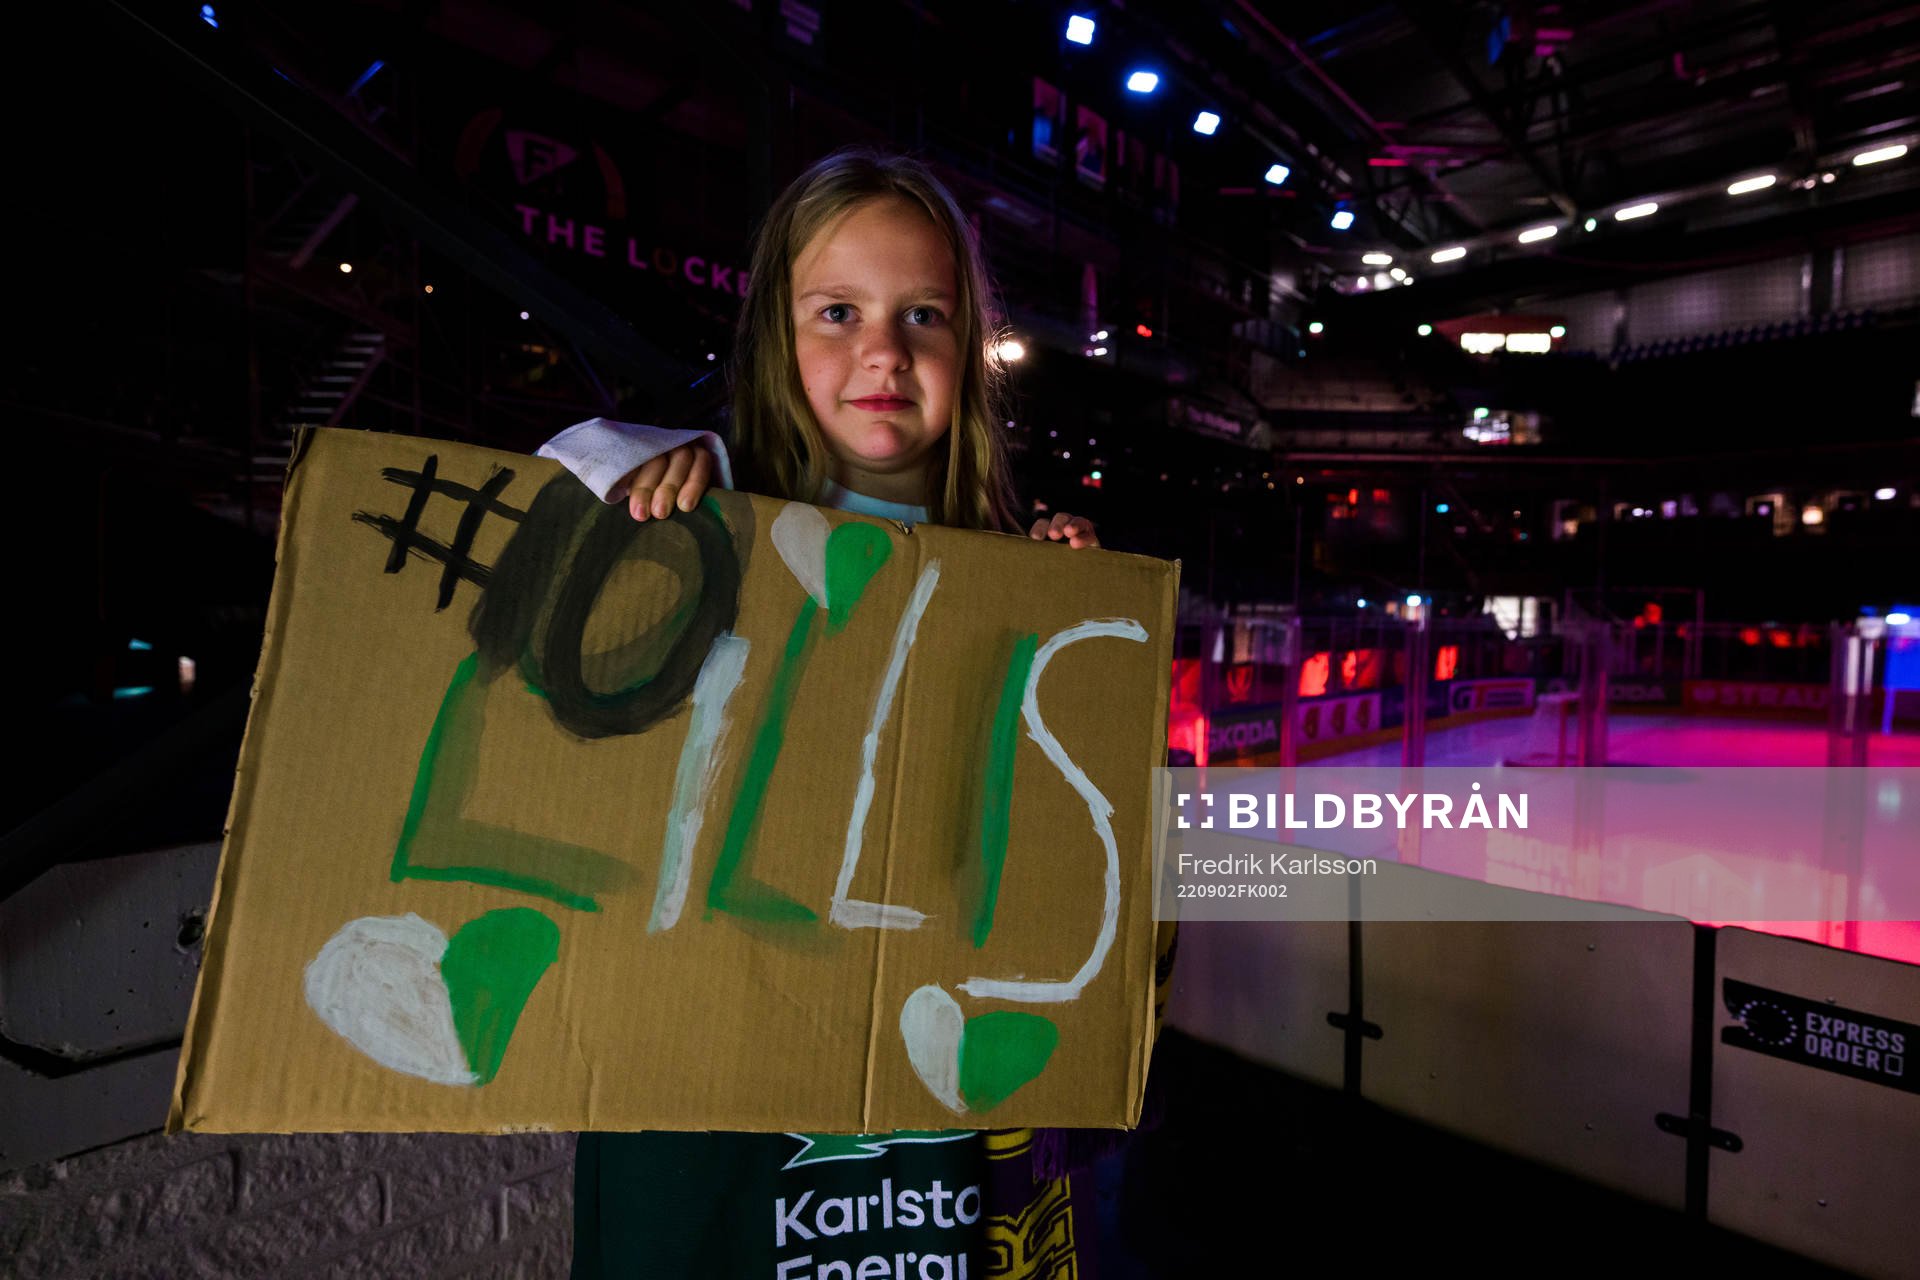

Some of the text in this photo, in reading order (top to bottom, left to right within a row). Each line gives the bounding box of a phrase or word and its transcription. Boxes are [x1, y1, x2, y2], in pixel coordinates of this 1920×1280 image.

[513, 202, 750, 299] THE LOCKE
[1804, 1010, 1906, 1055] EXPRESS
[1804, 1033, 1881, 1072] ORDER
[775, 1176, 982, 1248] Karlsta
